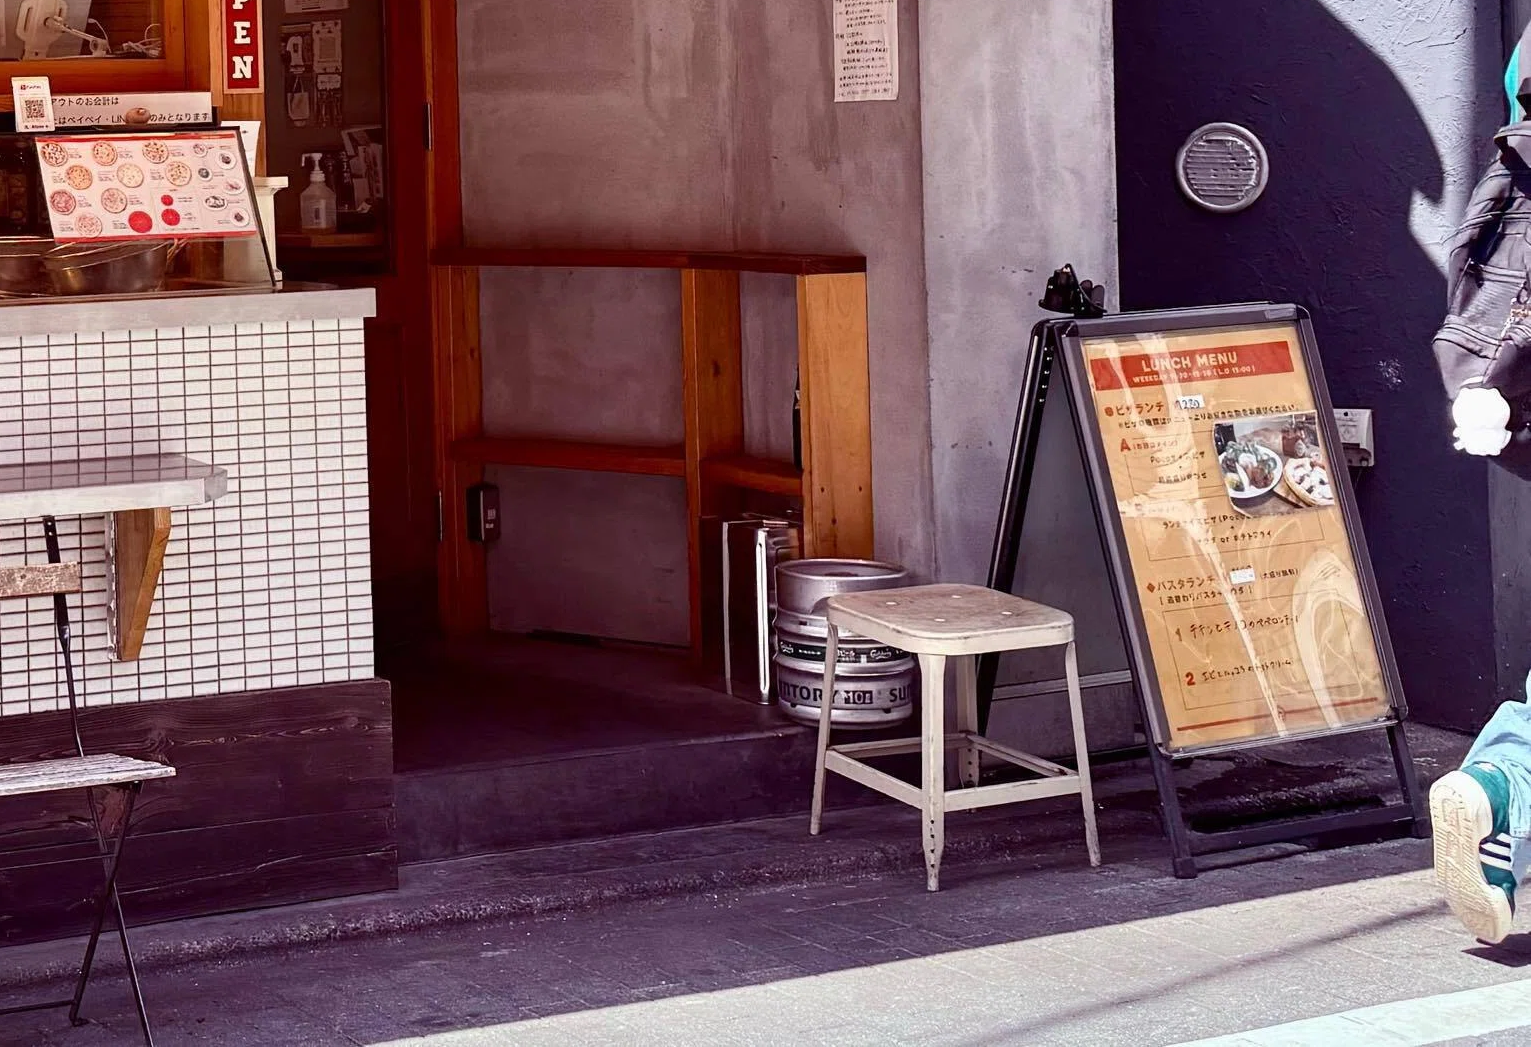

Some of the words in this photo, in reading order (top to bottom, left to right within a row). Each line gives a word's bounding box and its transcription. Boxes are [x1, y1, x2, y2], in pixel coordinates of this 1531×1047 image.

[1141, 355, 1191, 373] LUNCH
[1195, 351, 1238, 368] MENU
[1120, 438, 1131, 452] A
[1157, 574, 1216, 592] パスタランチ
[1185, 671, 1196, 686] 2
